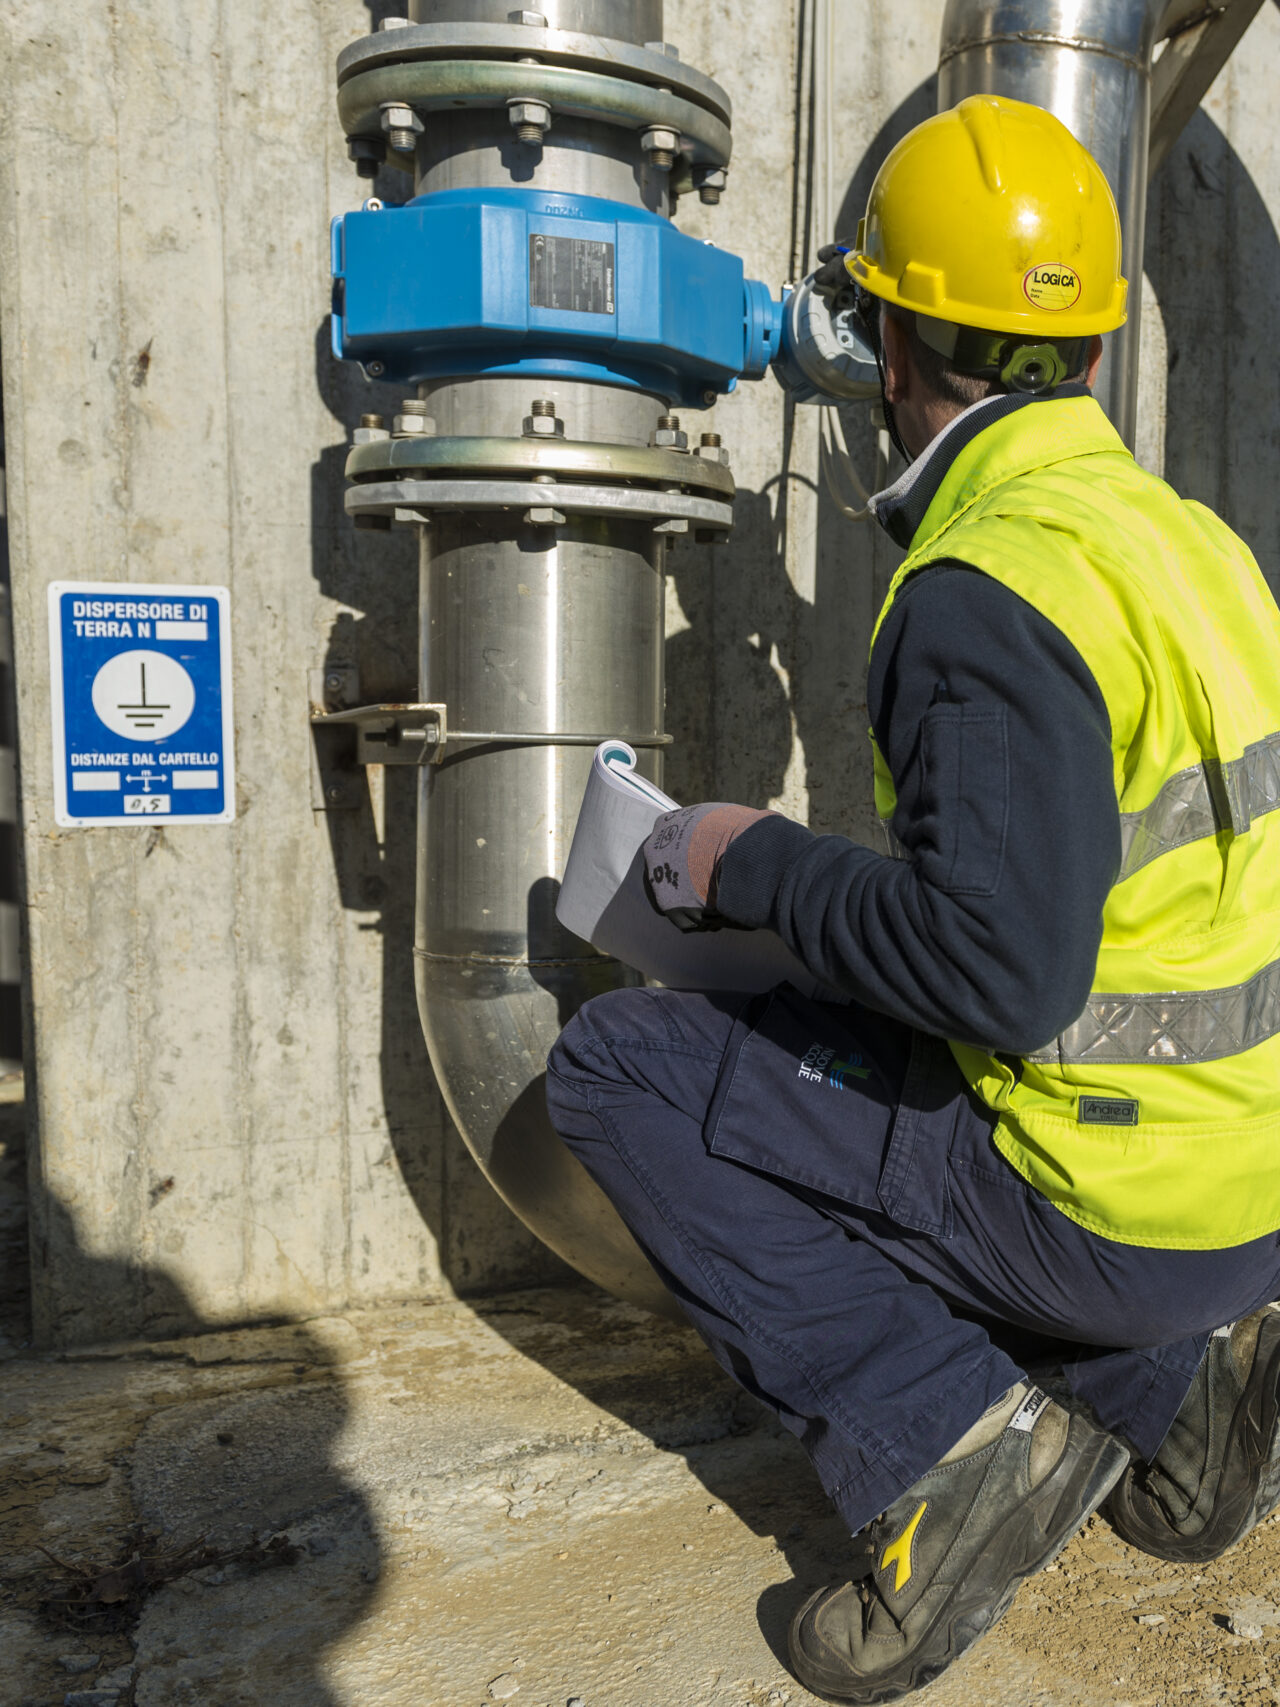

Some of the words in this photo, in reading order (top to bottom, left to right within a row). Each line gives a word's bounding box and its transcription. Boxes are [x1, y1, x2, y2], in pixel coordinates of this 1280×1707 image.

[73, 601, 184, 619] DISPERSORE
[189, 604, 208, 620] DI
[73, 620, 133, 638] TERRA
[137, 622, 151, 638] N
[71, 753, 130, 766] DISTANZE
[132, 753, 156, 765] DAL
[158, 752, 219, 765] CARTELLO
[1087, 1103, 1131, 1116] Andrea
